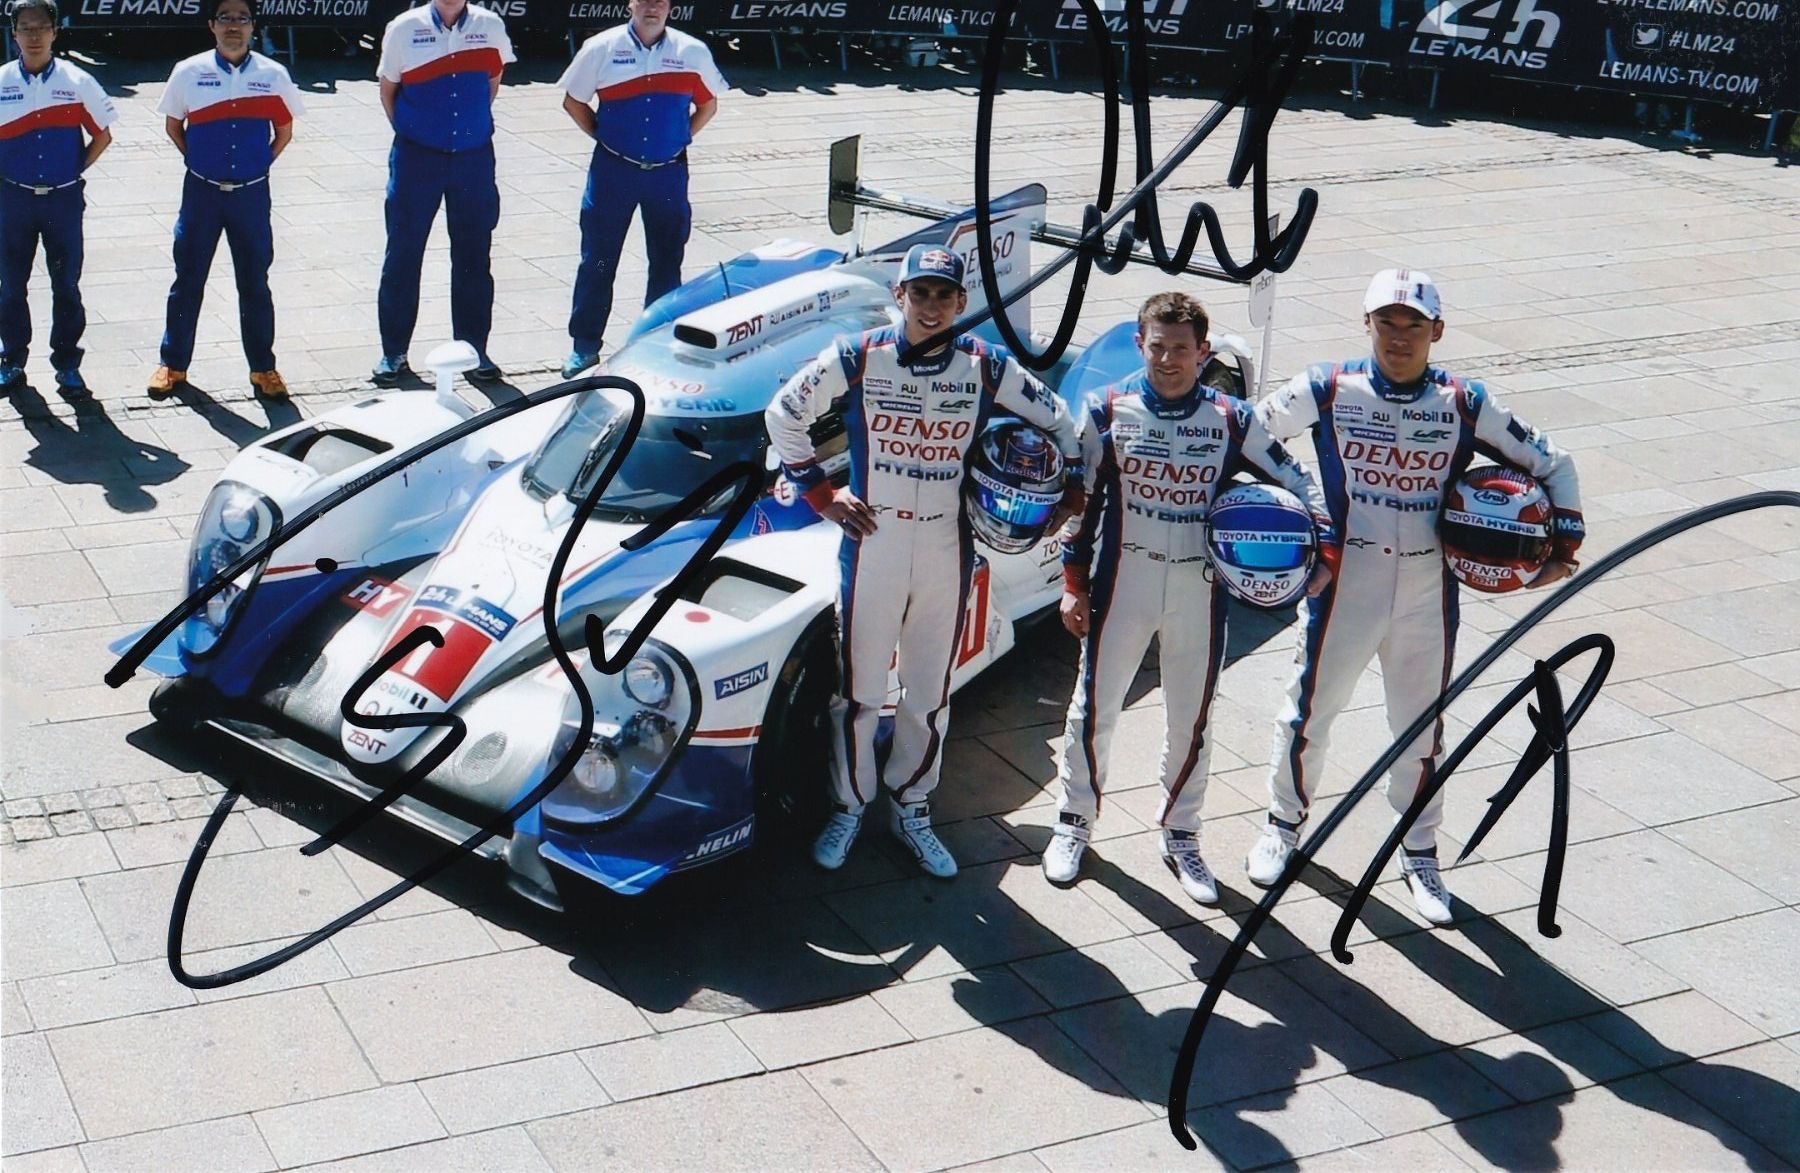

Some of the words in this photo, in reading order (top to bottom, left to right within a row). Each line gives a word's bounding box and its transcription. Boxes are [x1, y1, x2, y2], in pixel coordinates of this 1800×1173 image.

[81, 0, 115, 15] LE
[119, 0, 201, 15] MANS
[730, 3, 766, 20] LE
[768, 2, 848, 18] MANS
[1055, 13, 1088, 30] LE
[1408, 37, 1450, 56] LE
[1452, 42, 1548, 69] MANS
[1668, 30, 1736, 54] #LM24
[1598, 59, 1759, 94] LEMANS-TV.COM
[726, 313, 764, 347] ZENT
[931, 381, 963, 393] Mobil
[965, 382, 977, 394] 1
[1335, 403, 1364, 412] TOYOTA
[1402, 408, 1439, 422] Mobil
[1441, 411, 1455, 424] 1
[870, 413, 971, 440] DENSO
[1176, 425, 1210, 438] Mobil
[1211, 428, 1223, 440] 1
[876, 438, 962, 461] TOYOTA
[1342, 441, 1450, 471] DENSO
[873, 459, 960, 482] HYBRID
[1122, 456, 1217, 485] DENSO
[1351, 467, 1440, 492] TOYOTA
[977, 472, 1015, 498] TOYOTA
[1127, 479, 1208, 506] TOYOTA
[1351, 487, 1439, 513] HYBRID
[1449, 511, 1485, 525] TOYOTA
[1486, 518, 1537, 535] HYBRID
[1218, 531, 1258, 542] TOYOTA
[1259, 533, 1307, 543] HYBRID
[1460, 560, 1512, 578] DENSO
[348, 579, 406, 610] HY
[1241, 578, 1291, 591] DENSO
[720, 665, 766, 696] AISIN
[346, 728, 387, 755] ZENT
[686, 823, 753, 860] HELIN
